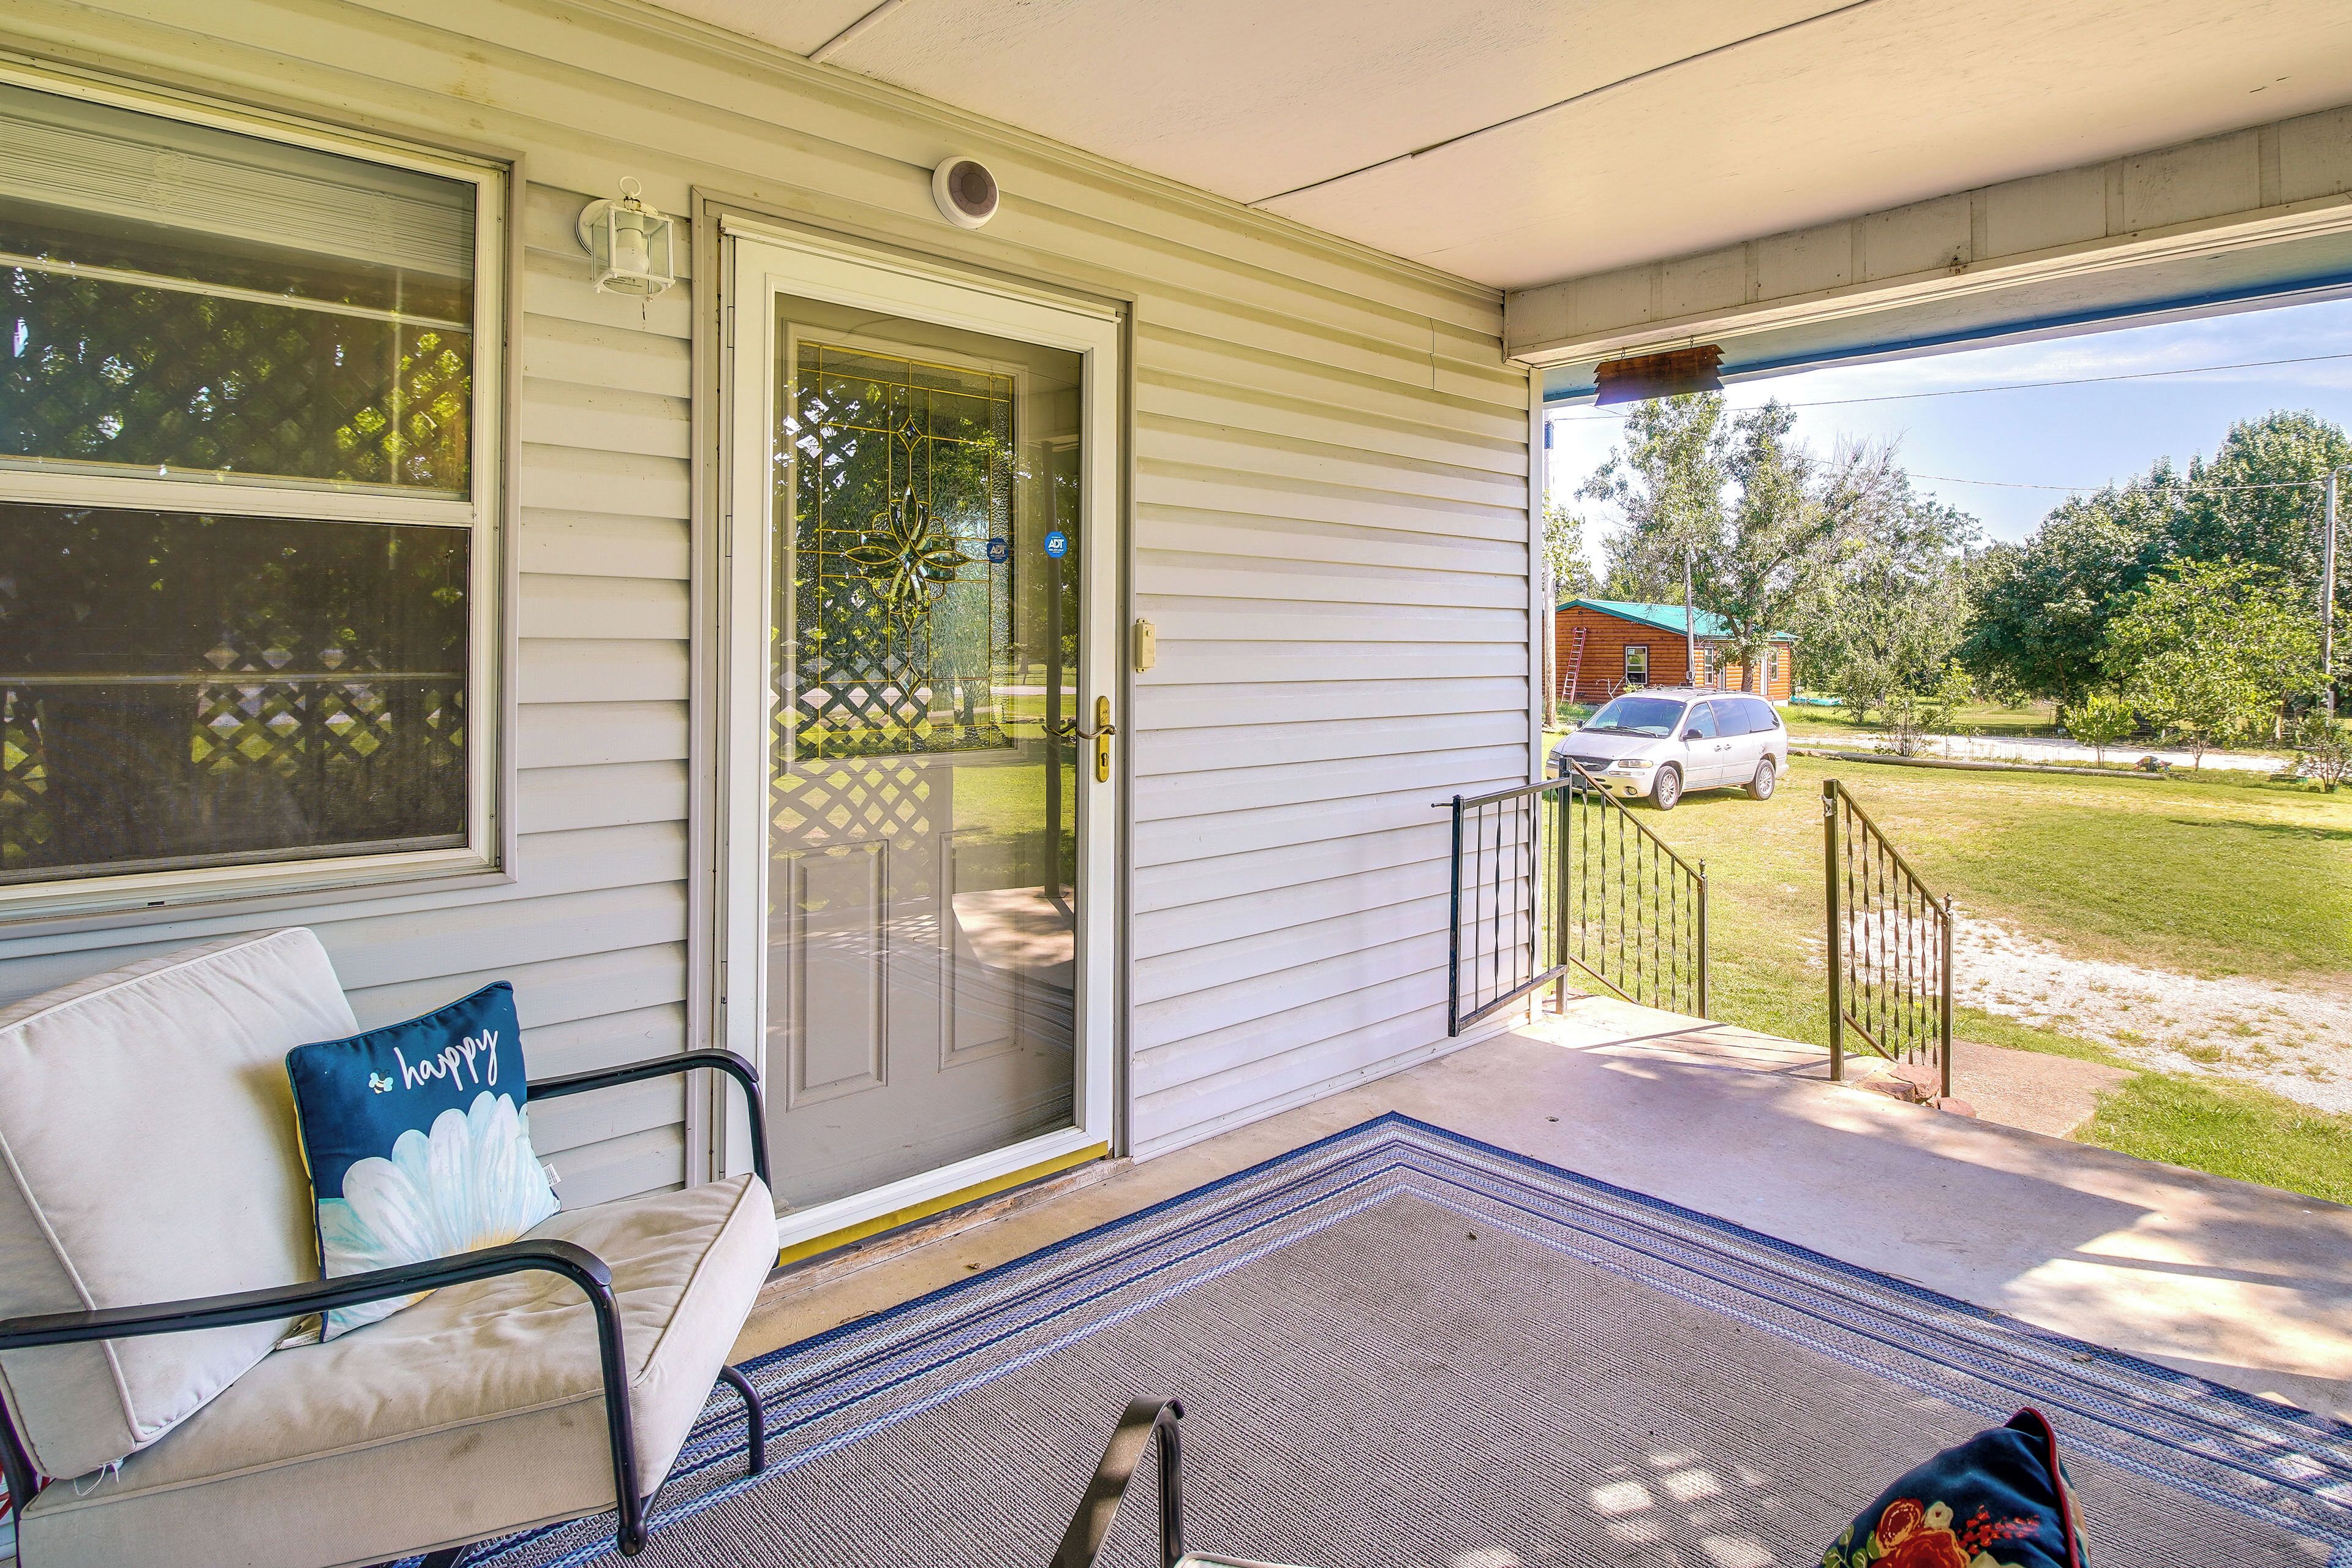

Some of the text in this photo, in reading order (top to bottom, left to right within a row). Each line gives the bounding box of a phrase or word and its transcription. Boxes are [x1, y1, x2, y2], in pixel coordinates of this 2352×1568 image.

[1048, 539, 1065, 548] ADT
[990, 545, 1006, 554] ADT
[393, 1029, 498, 1091] happy
